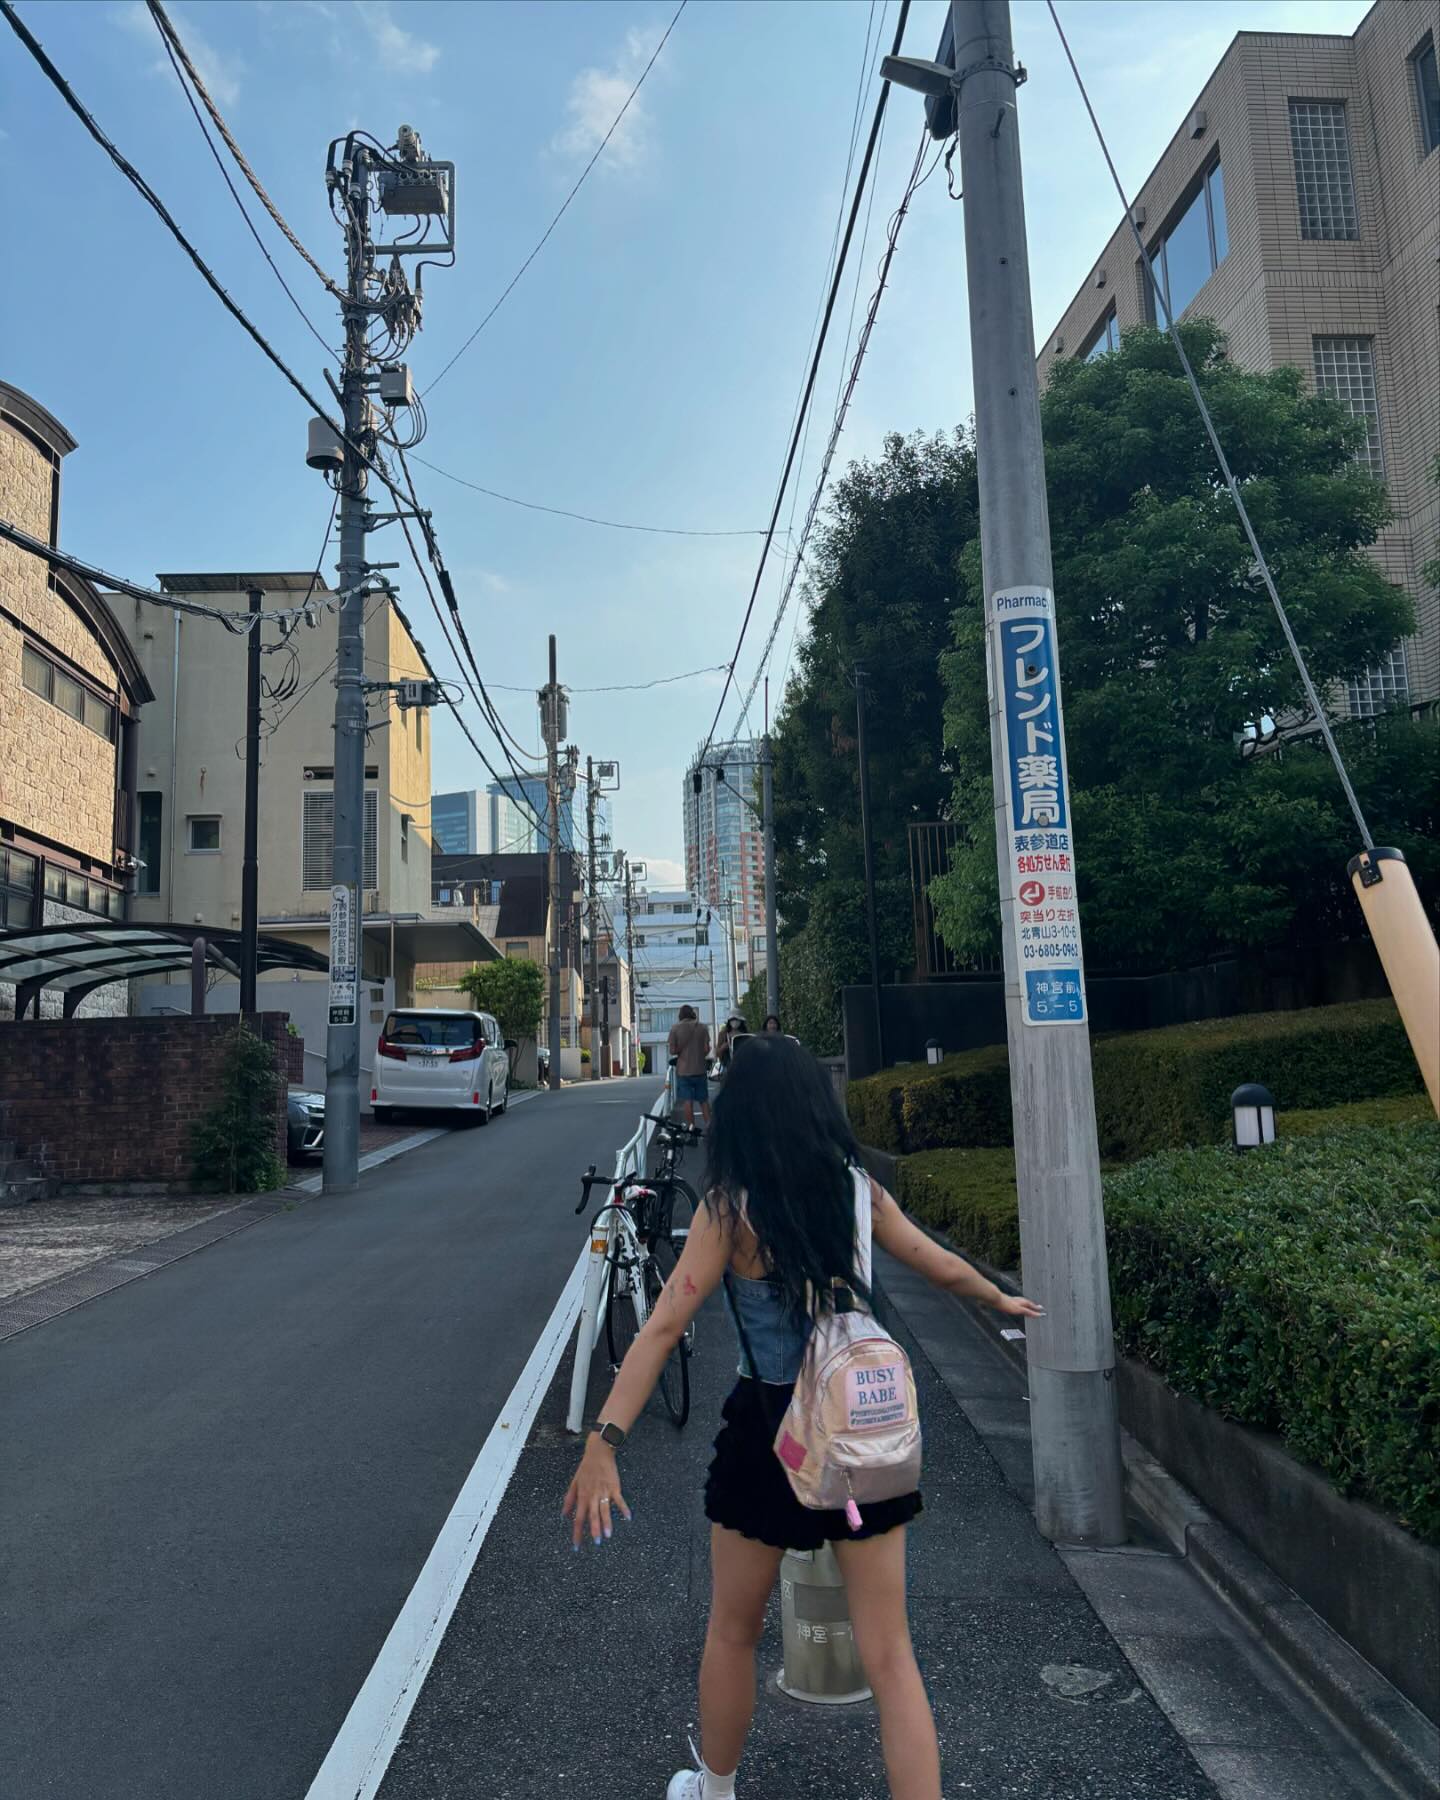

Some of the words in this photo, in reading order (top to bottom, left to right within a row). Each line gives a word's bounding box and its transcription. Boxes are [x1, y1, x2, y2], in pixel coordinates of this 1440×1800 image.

[1010, 624, 1060, 825] フレンド薬局
[1014, 833, 1069, 852] 表参道店
[1017, 855, 1071, 874] 各処方せん受付
[1035, 981, 1076, 994] 神宮前
[856, 1366, 896, 1385] BUSY
[858, 1386, 897, 1405] BABE
